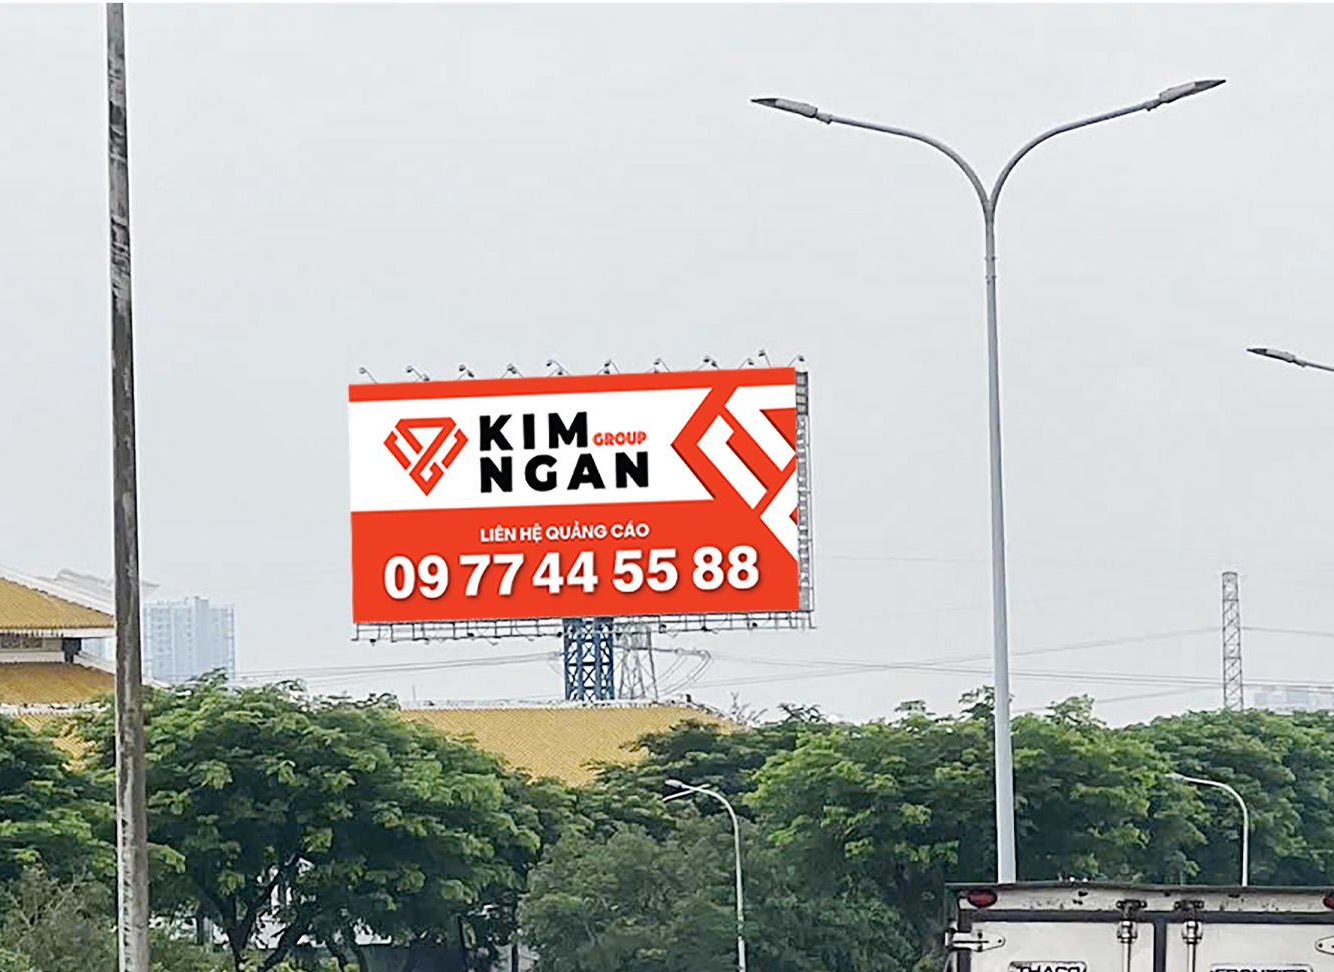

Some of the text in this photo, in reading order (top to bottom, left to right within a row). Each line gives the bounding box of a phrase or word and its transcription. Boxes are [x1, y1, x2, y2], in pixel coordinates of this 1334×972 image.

[479, 411, 588, 451] KIM
[592, 431, 648, 446] GROUP
[479, 451, 649, 493] NGAN
[480, 520, 650, 543] LIÊN HỆ QUẢNG CÁO
[384, 545, 759, 600] 09 77 44 55 88
